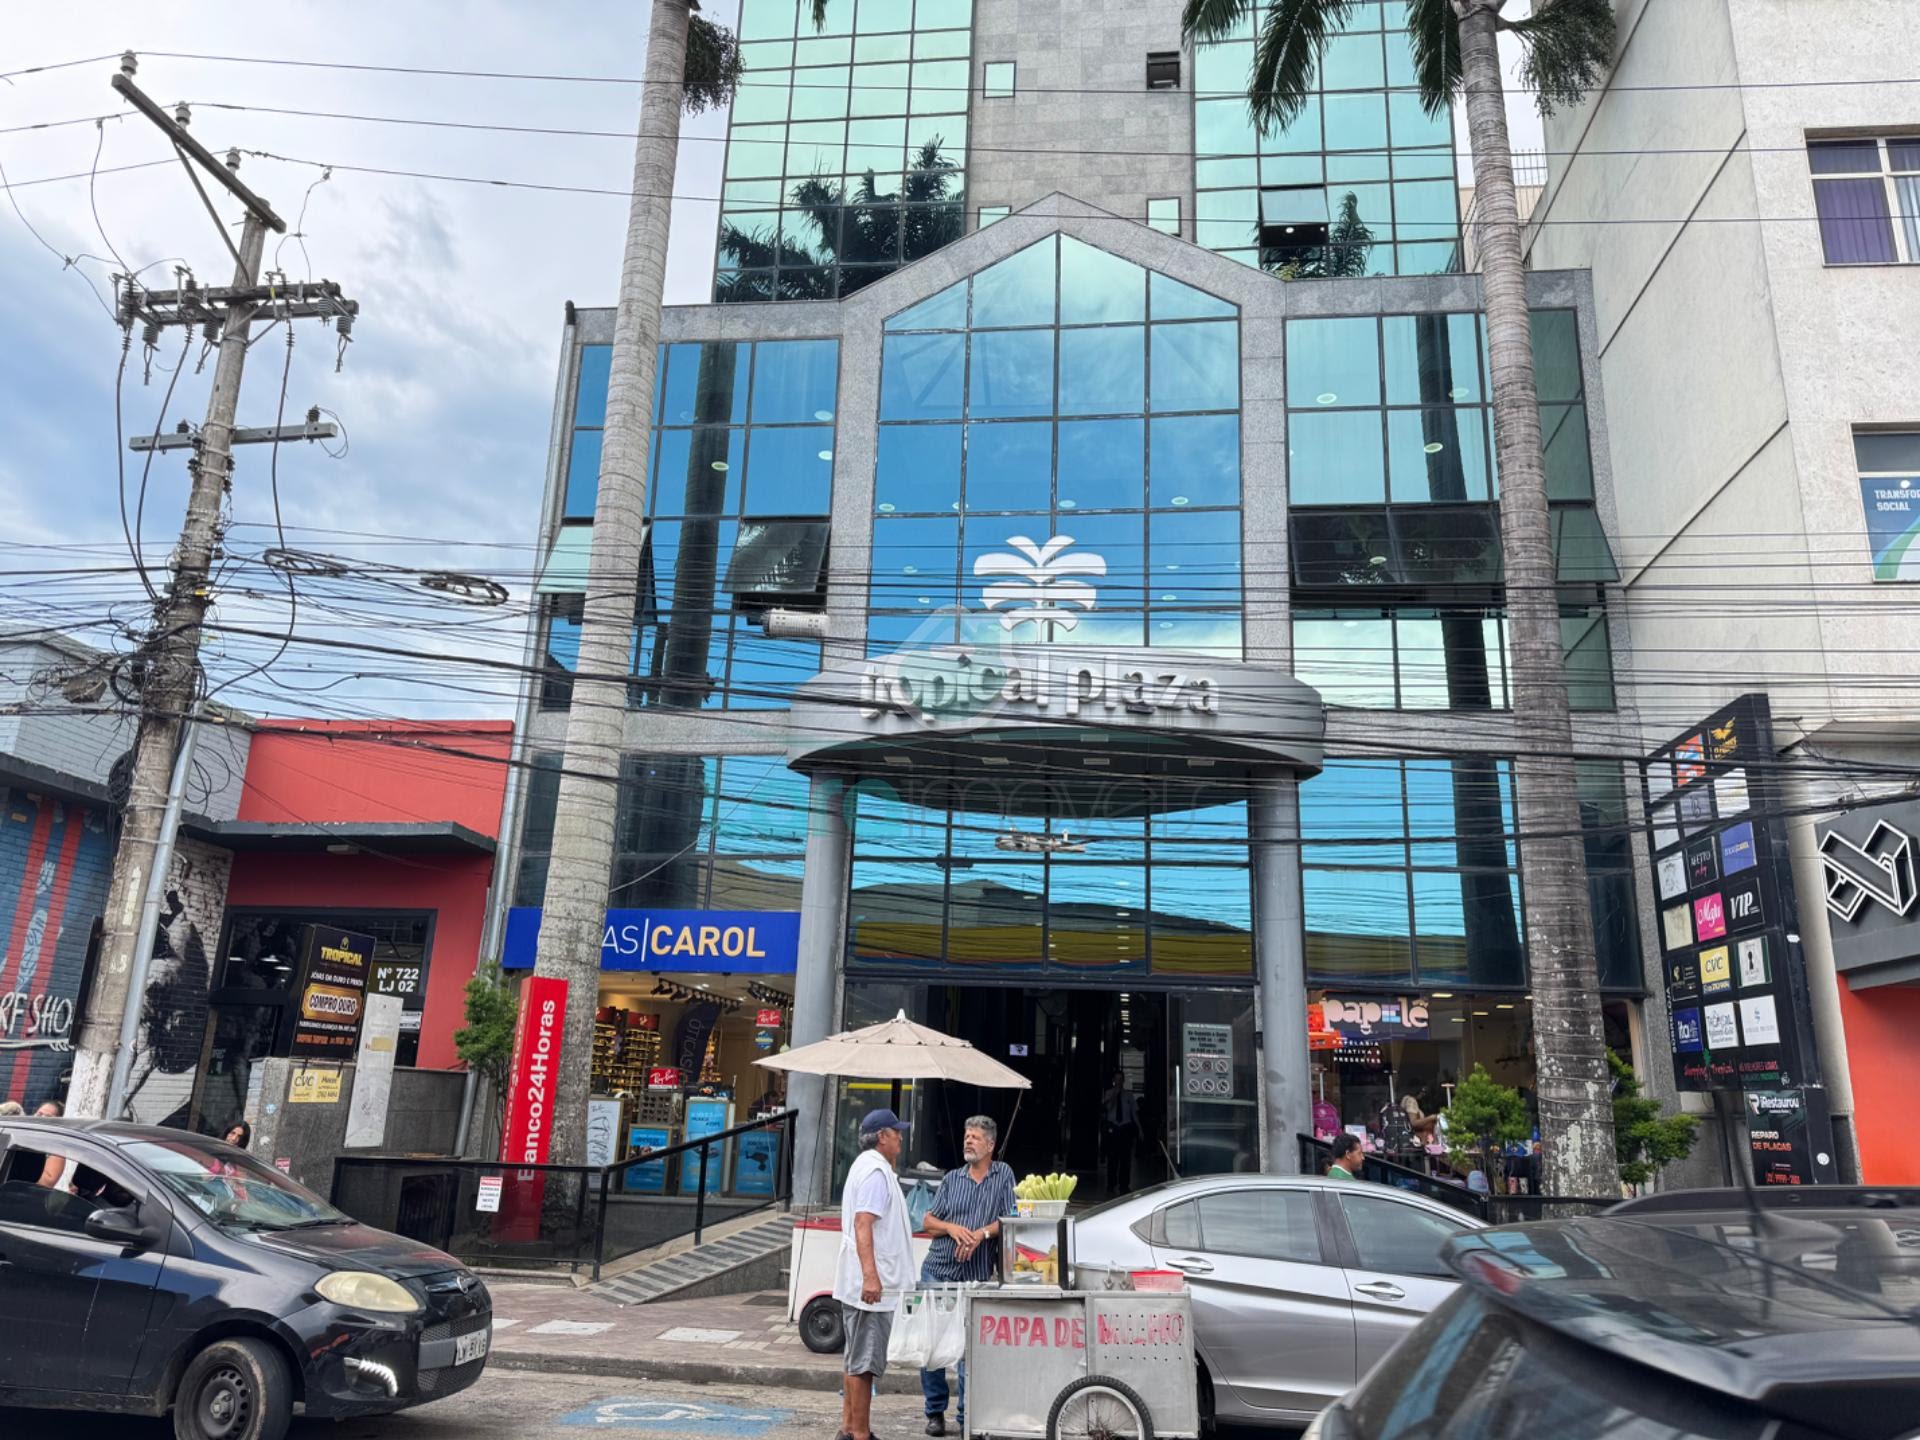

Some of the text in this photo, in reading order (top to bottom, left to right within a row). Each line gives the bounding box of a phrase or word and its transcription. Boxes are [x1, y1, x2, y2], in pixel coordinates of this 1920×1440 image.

[1876, 501, 1911, 512] SOCIAL
[860, 654, 1220, 721] tropical plaza
[1730, 891, 1753, 920] VIP
[651, 925, 766, 957] CAROL
[321, 947, 363, 966] TROPICAL
[1704, 956, 1724, 974] CVC
[396, 968, 419, 980] 722
[379, 981, 414, 993] LJ 02
[309, 994, 357, 1015] COMPRO OURO
[28, 994, 74, 1036] SHO
[1333, 1056, 1382, 1064] PRESENTES
[1752, 1141, 1763, 1150] DE
[978, 1314, 1048, 1349] PAPA
[1053, 1317, 1086, 1349] DE
